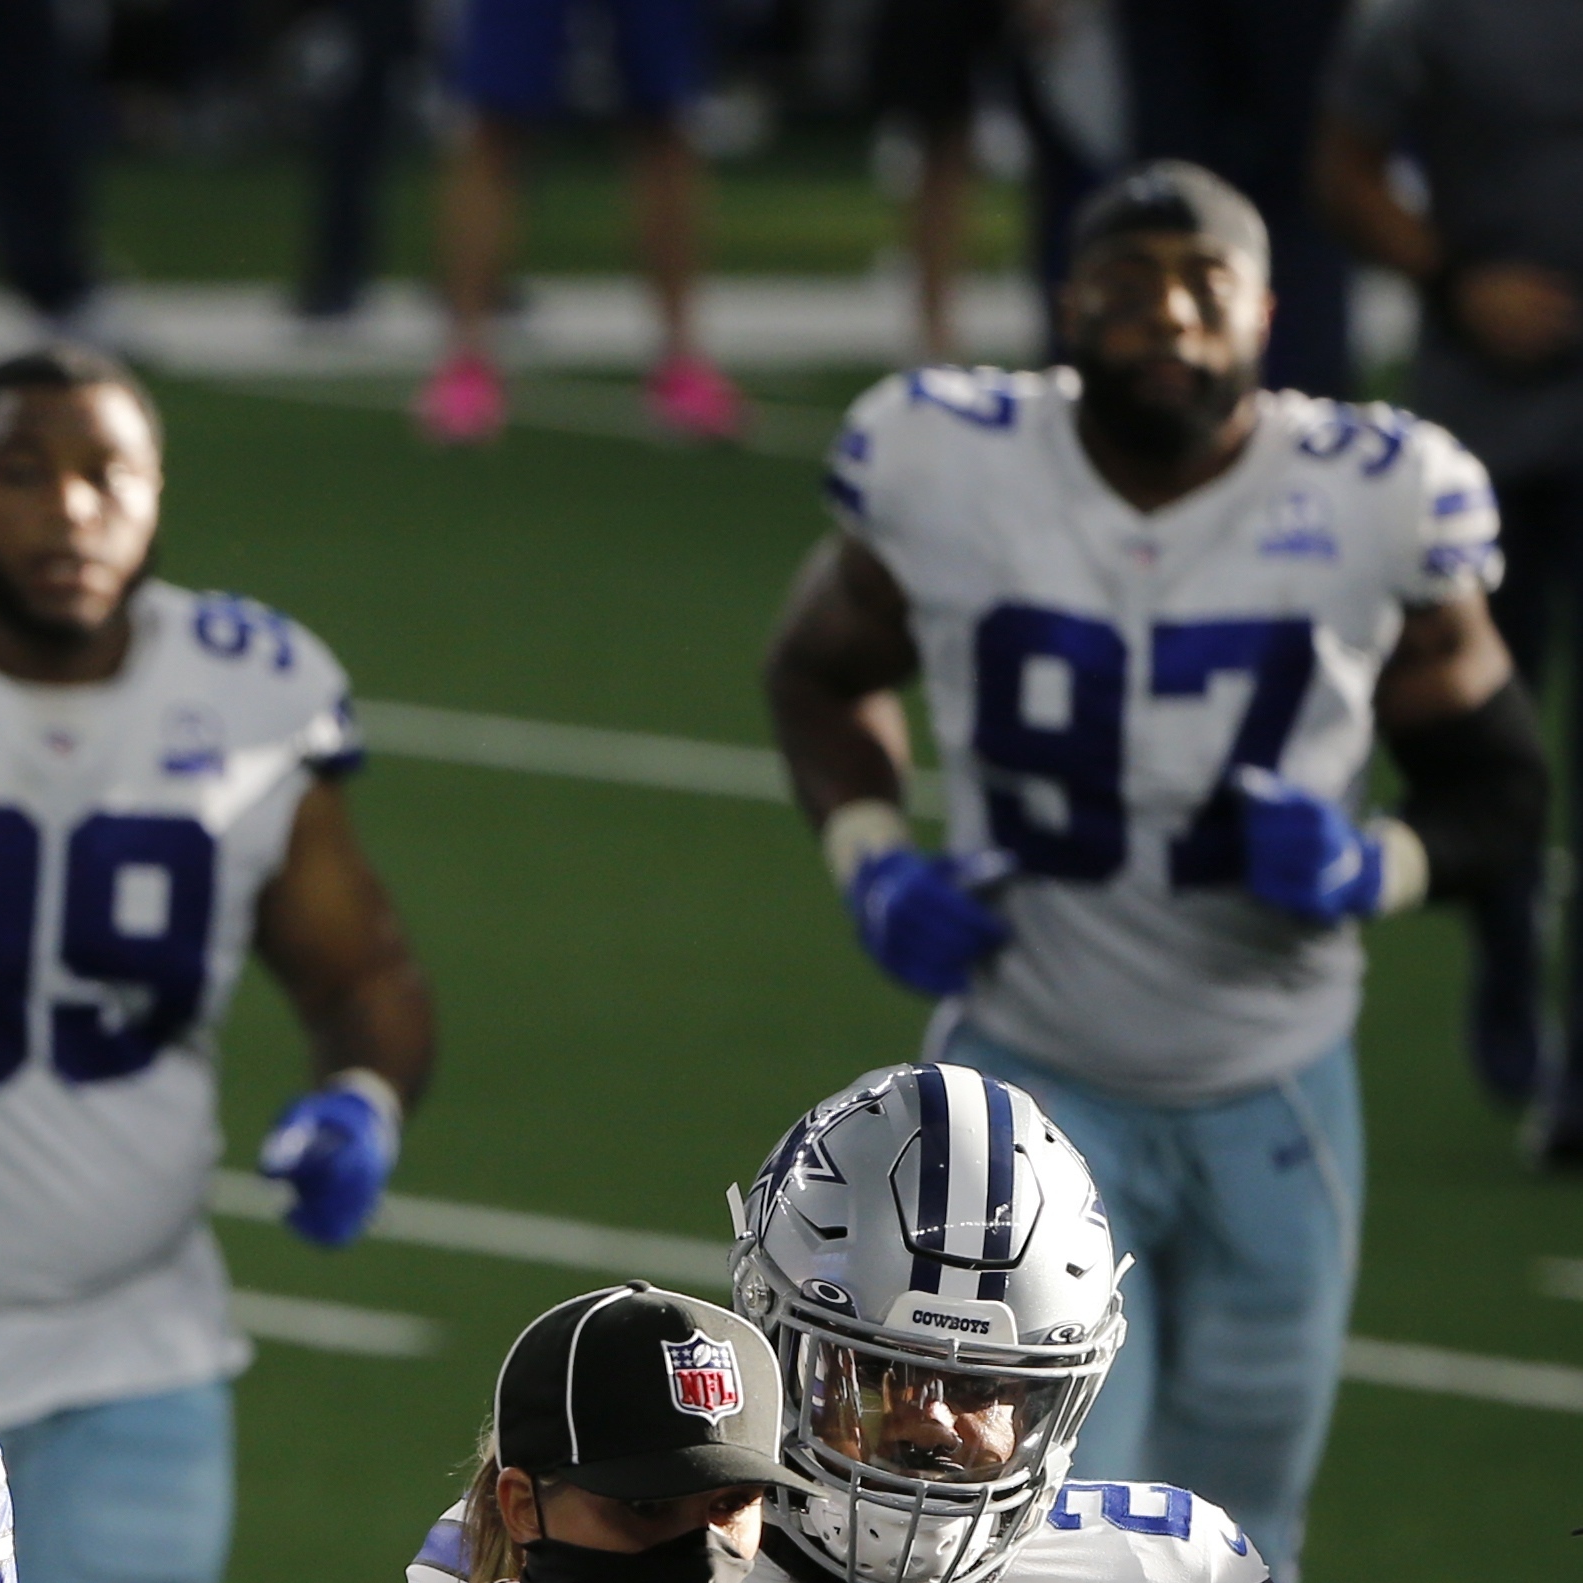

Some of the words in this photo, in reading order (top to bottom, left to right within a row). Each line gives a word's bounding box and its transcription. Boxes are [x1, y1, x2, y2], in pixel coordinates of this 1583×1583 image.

[974, 605, 1314, 885] 97
[912, 1309, 990, 1335] COWBOYS
[677, 1371, 739, 1410] NFL
